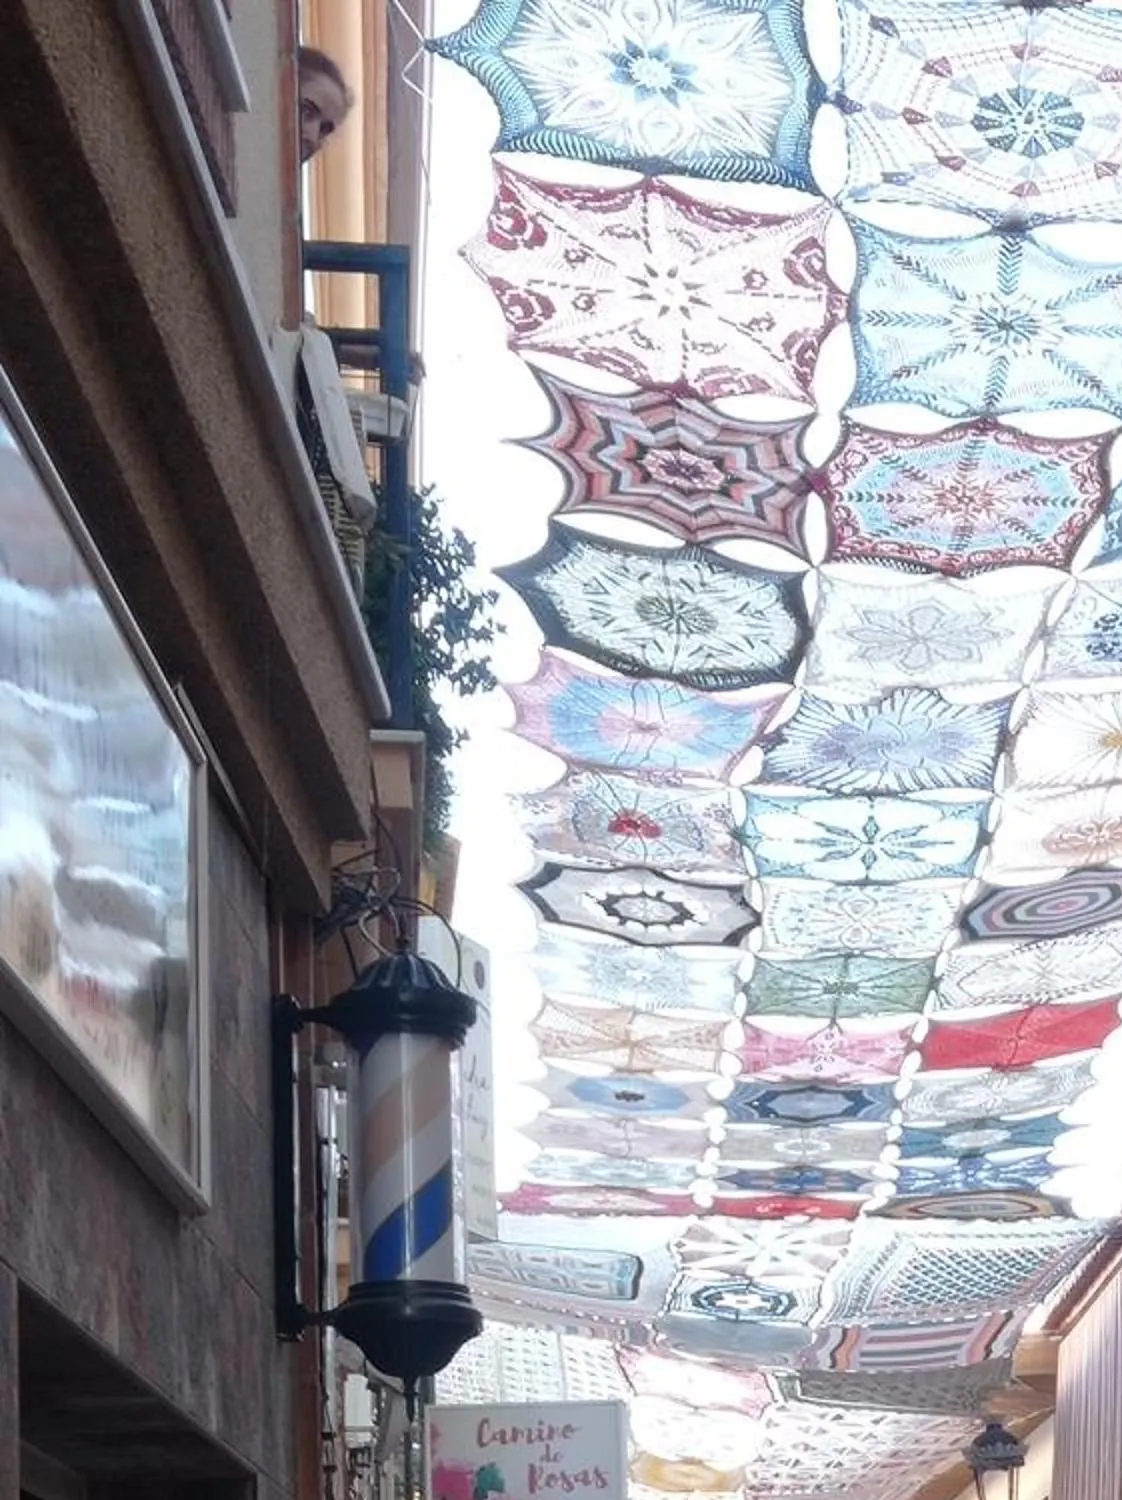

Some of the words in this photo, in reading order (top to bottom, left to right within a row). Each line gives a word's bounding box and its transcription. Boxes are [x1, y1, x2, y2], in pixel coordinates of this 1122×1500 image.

[477, 1416, 581, 1448] Camino
[540, 1443, 564, 1463] de
[527, 1463, 610, 1494] Rosas
